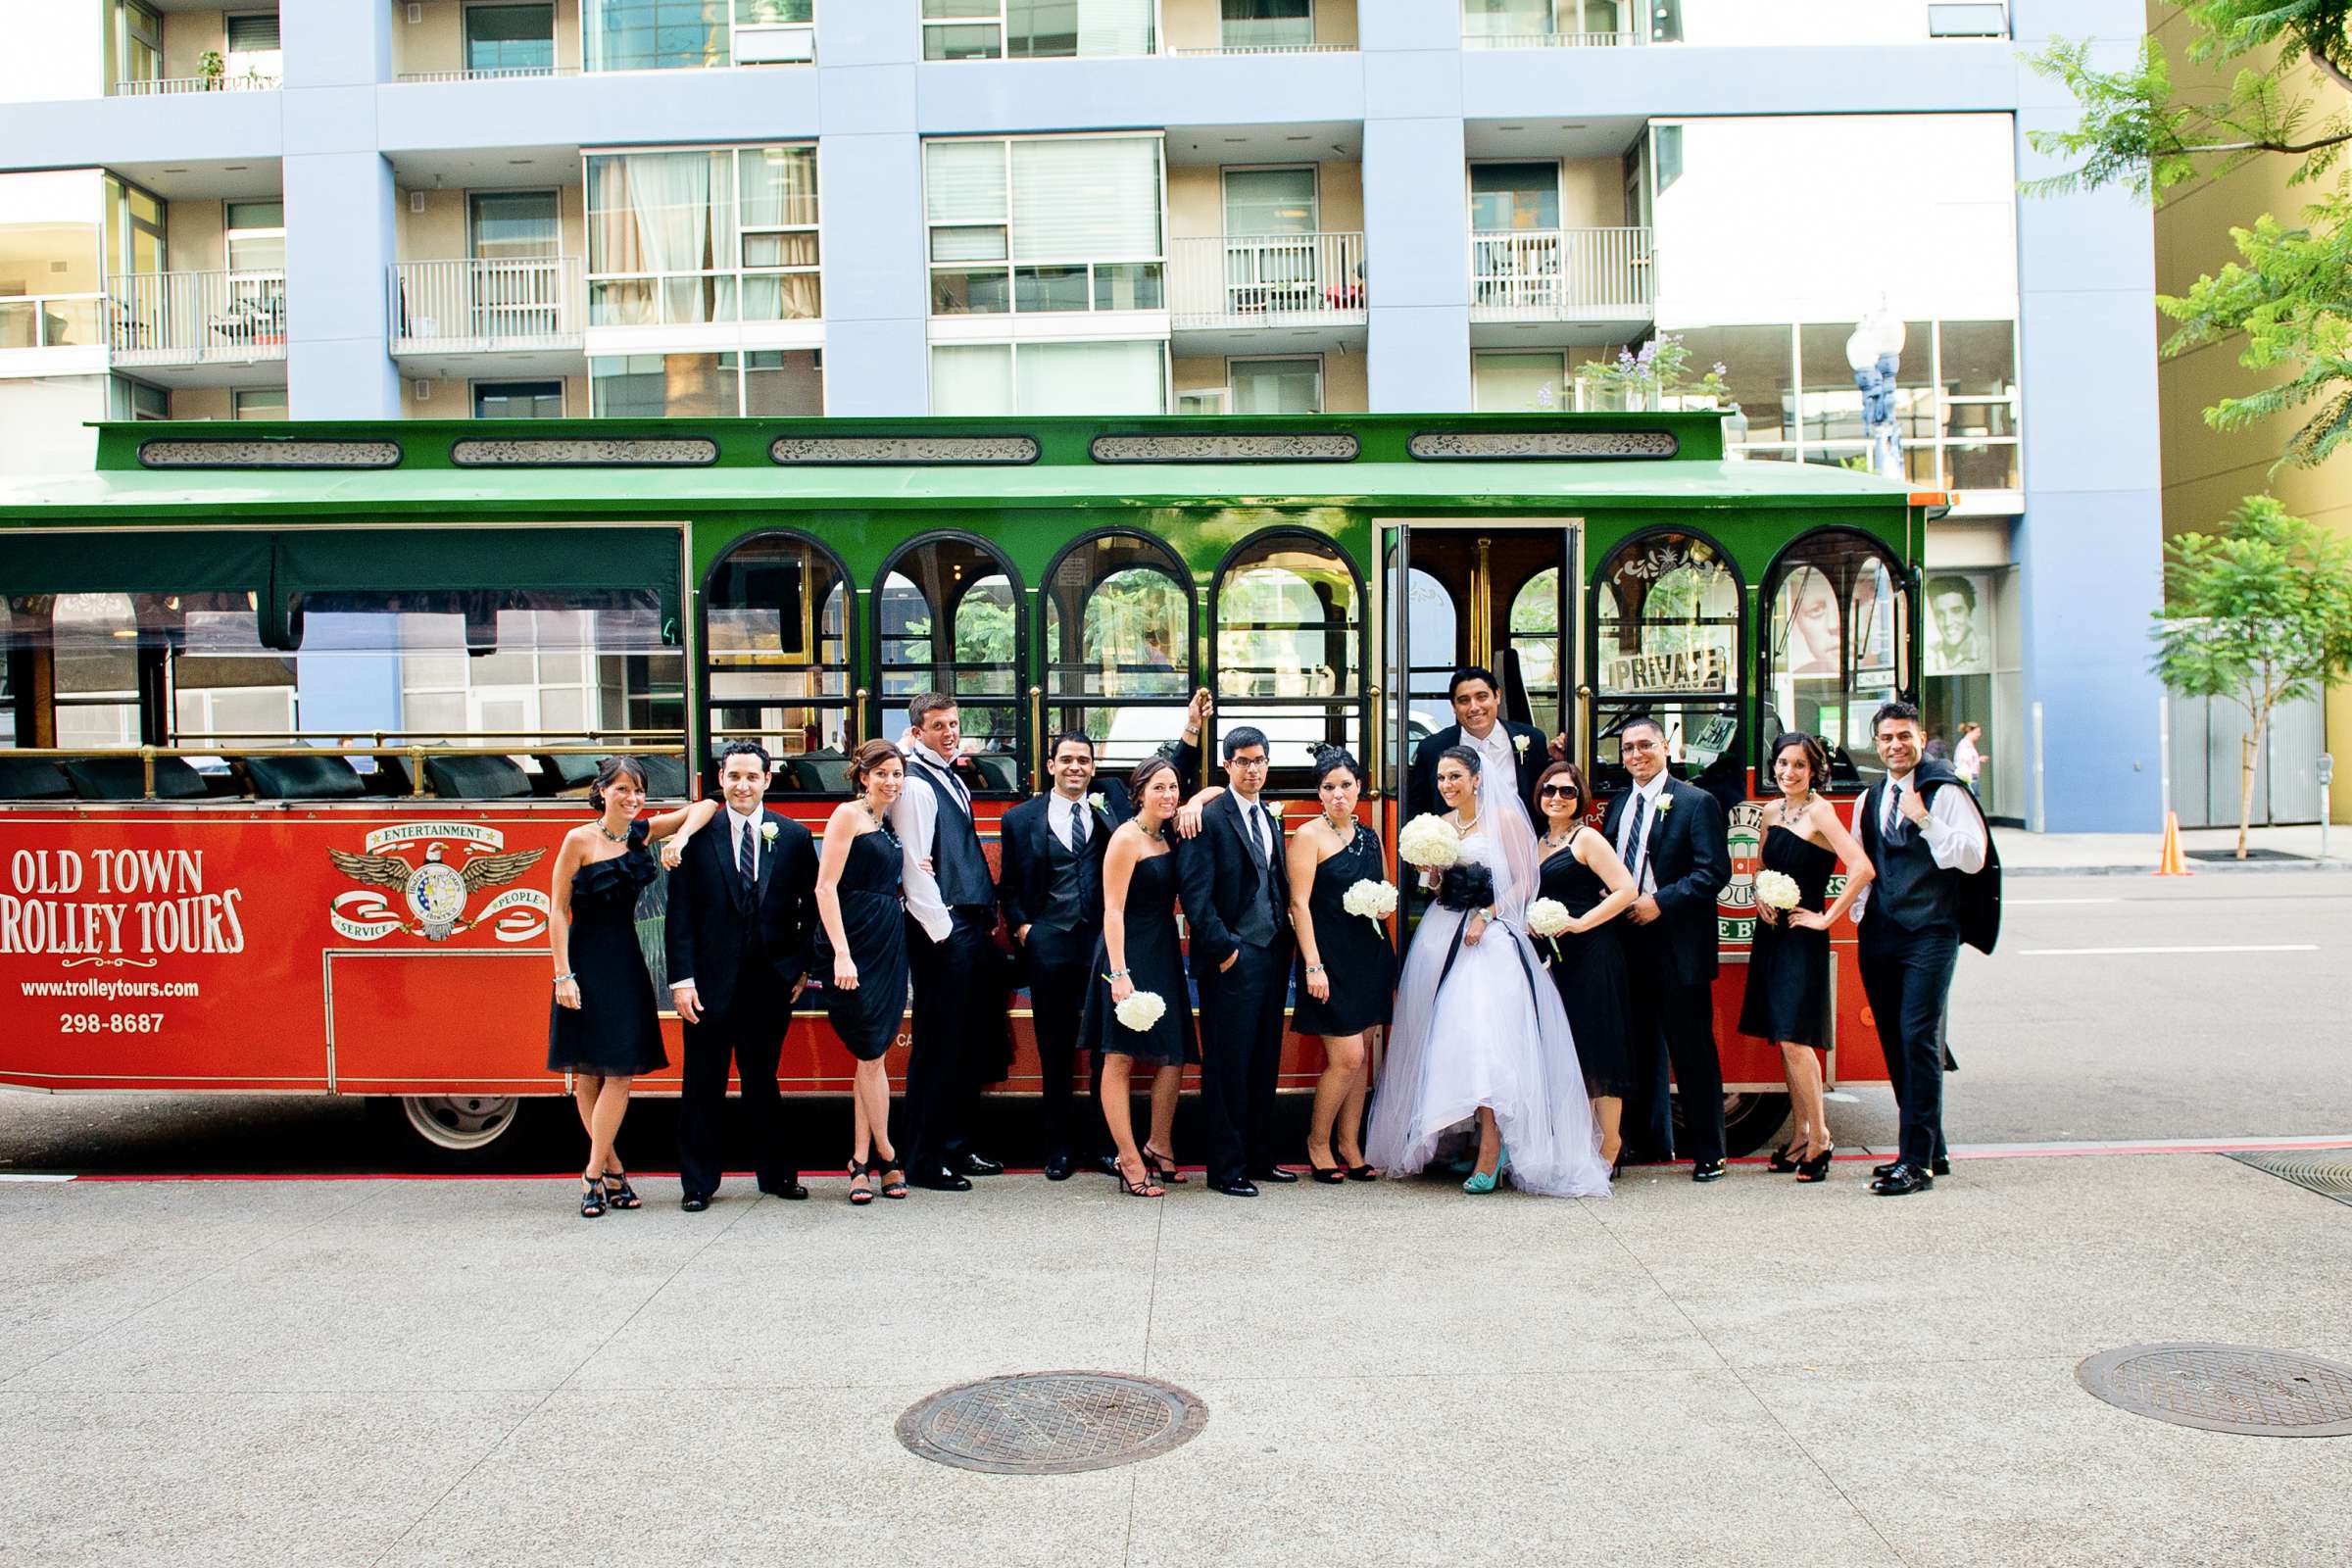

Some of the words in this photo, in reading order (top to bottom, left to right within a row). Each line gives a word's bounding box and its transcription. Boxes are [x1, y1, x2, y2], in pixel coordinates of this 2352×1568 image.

[1615, 649, 1721, 690] PRIVATE
[383, 824, 482, 841] ENTERTAINMENT
[12, 849, 82, 894] OLD
[91, 849, 203, 894] TOWN
[498, 892, 540, 907] PEOPLE
[0, 893, 127, 955] ROLLEY
[135, 887, 244, 955] TOURS
[340, 923, 389, 936] SERVICE
[21, 978, 199, 1001] www.trolleytours.com
[60, 1013, 165, 1033] 298-8687
[896, 1033, 912, 1048] CA
